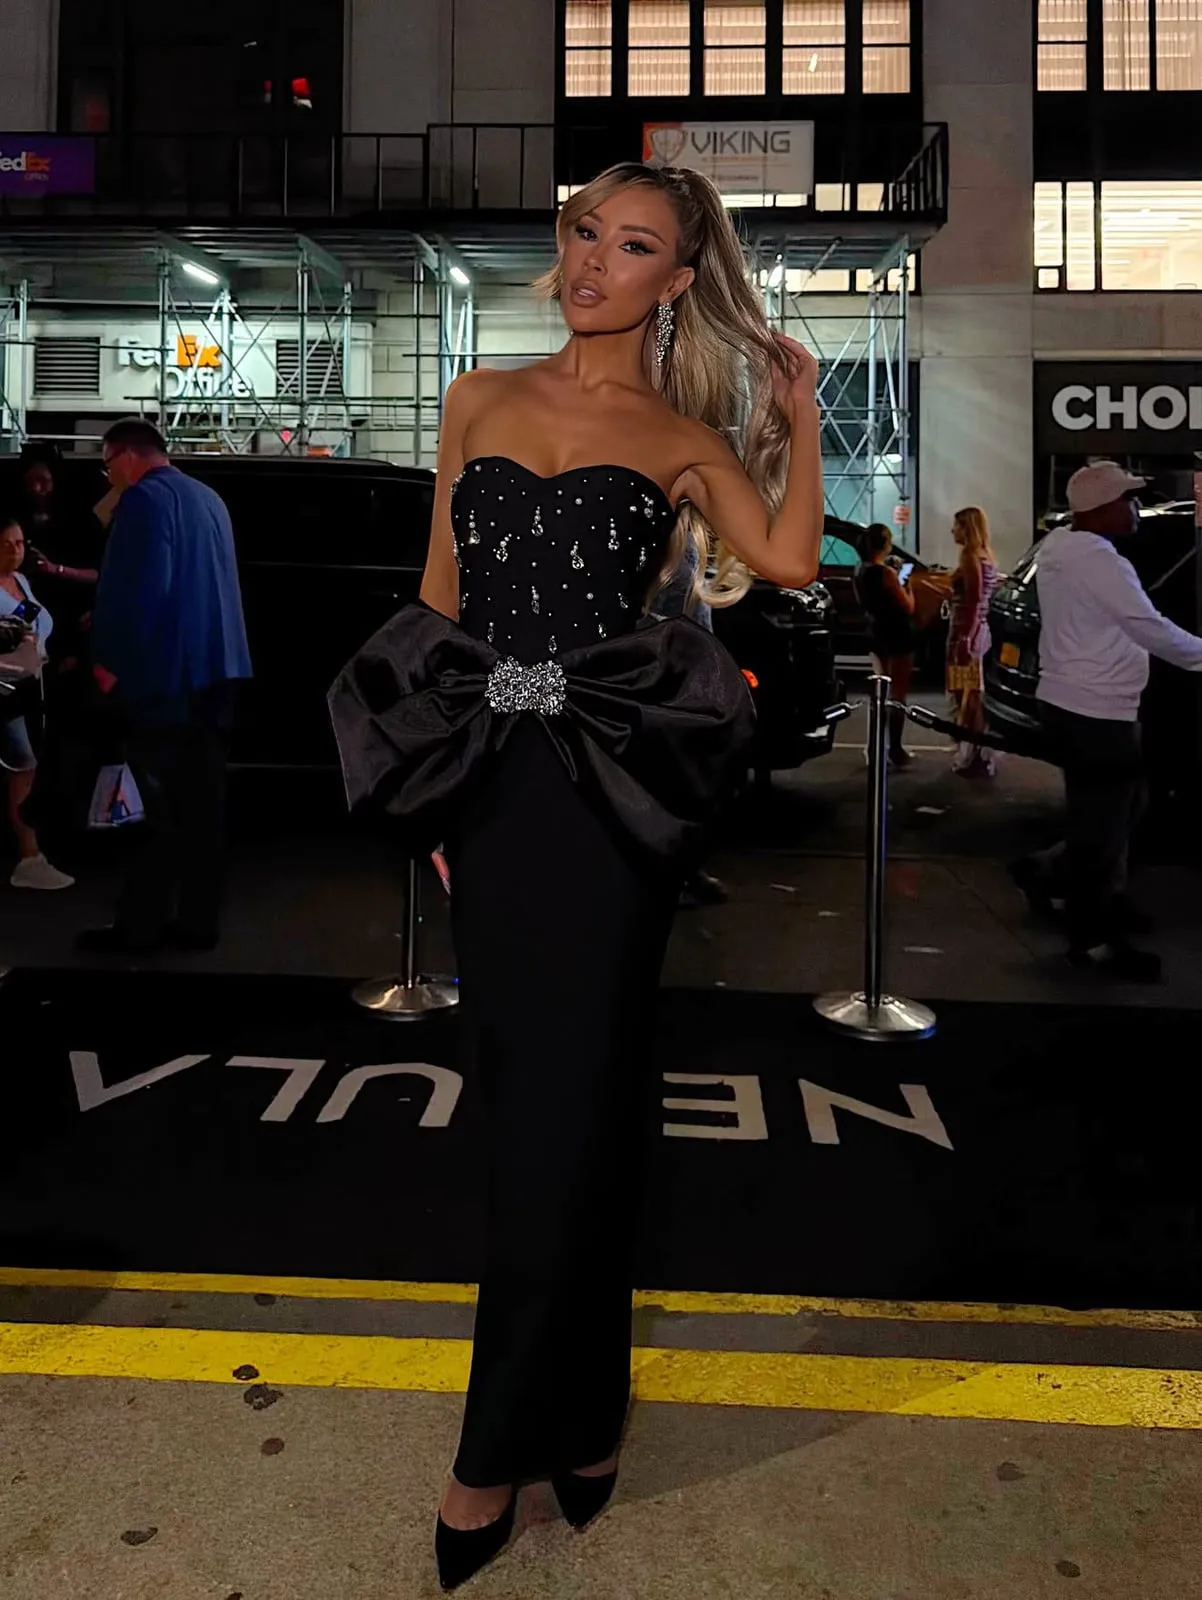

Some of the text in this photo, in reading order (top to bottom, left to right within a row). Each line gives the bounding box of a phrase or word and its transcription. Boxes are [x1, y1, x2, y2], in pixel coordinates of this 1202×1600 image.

[691, 131, 791, 154] VIKING
[0, 151, 52, 171] edEx
[118, 335, 222, 367] FedEx
[69, 1051, 955, 1151] NEULA
